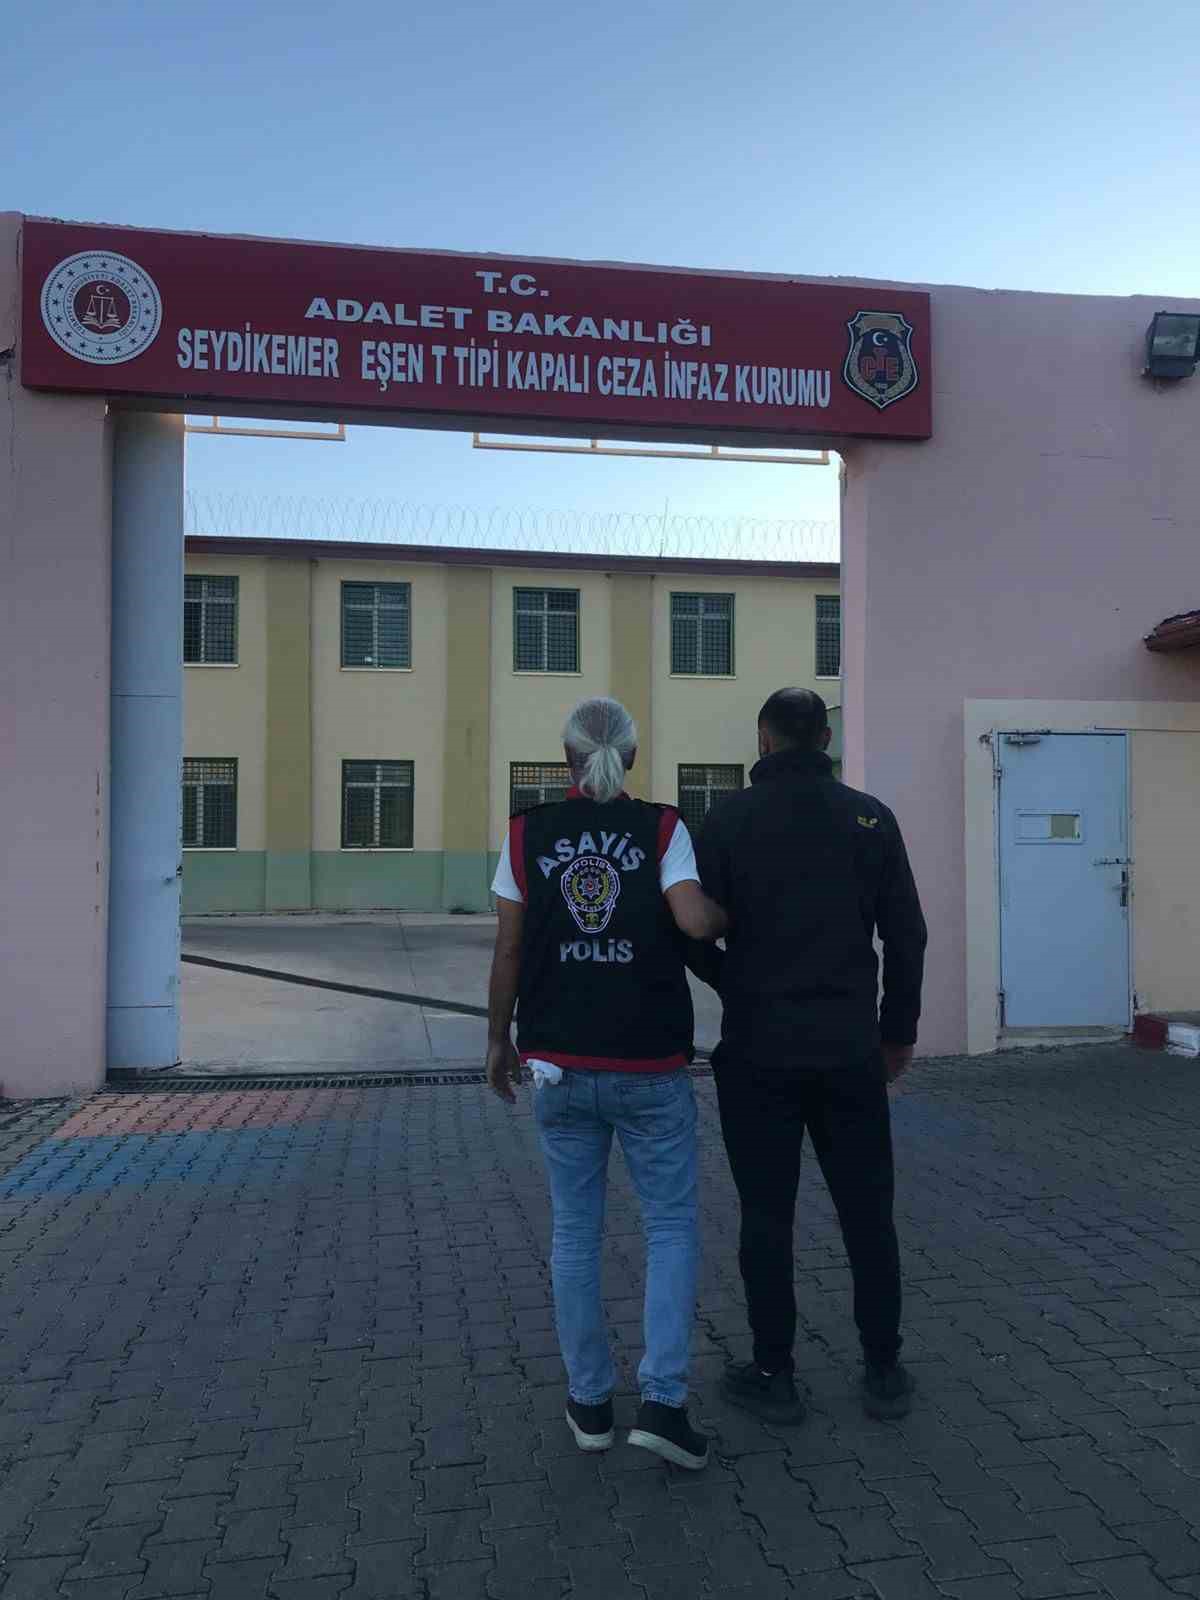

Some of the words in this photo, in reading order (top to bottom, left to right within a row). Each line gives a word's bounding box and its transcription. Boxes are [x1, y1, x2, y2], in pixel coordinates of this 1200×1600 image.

[475, 270, 549, 297] T.C.
[303, 296, 473, 330] ADALET
[486, 308, 712, 347] BAKANLIĞI
[176, 321, 340, 378] SEYDİKEMER
[361, 339, 424, 391] EŞEN
[431, 344, 447, 385] T
[453, 336, 499, 388] TİPİ
[506, 349, 590, 394] KAPALI
[596, 355, 659, 398] CEZA
[664, 351, 729, 402] İNFAZ
[735, 364, 831, 408] KURUMU
